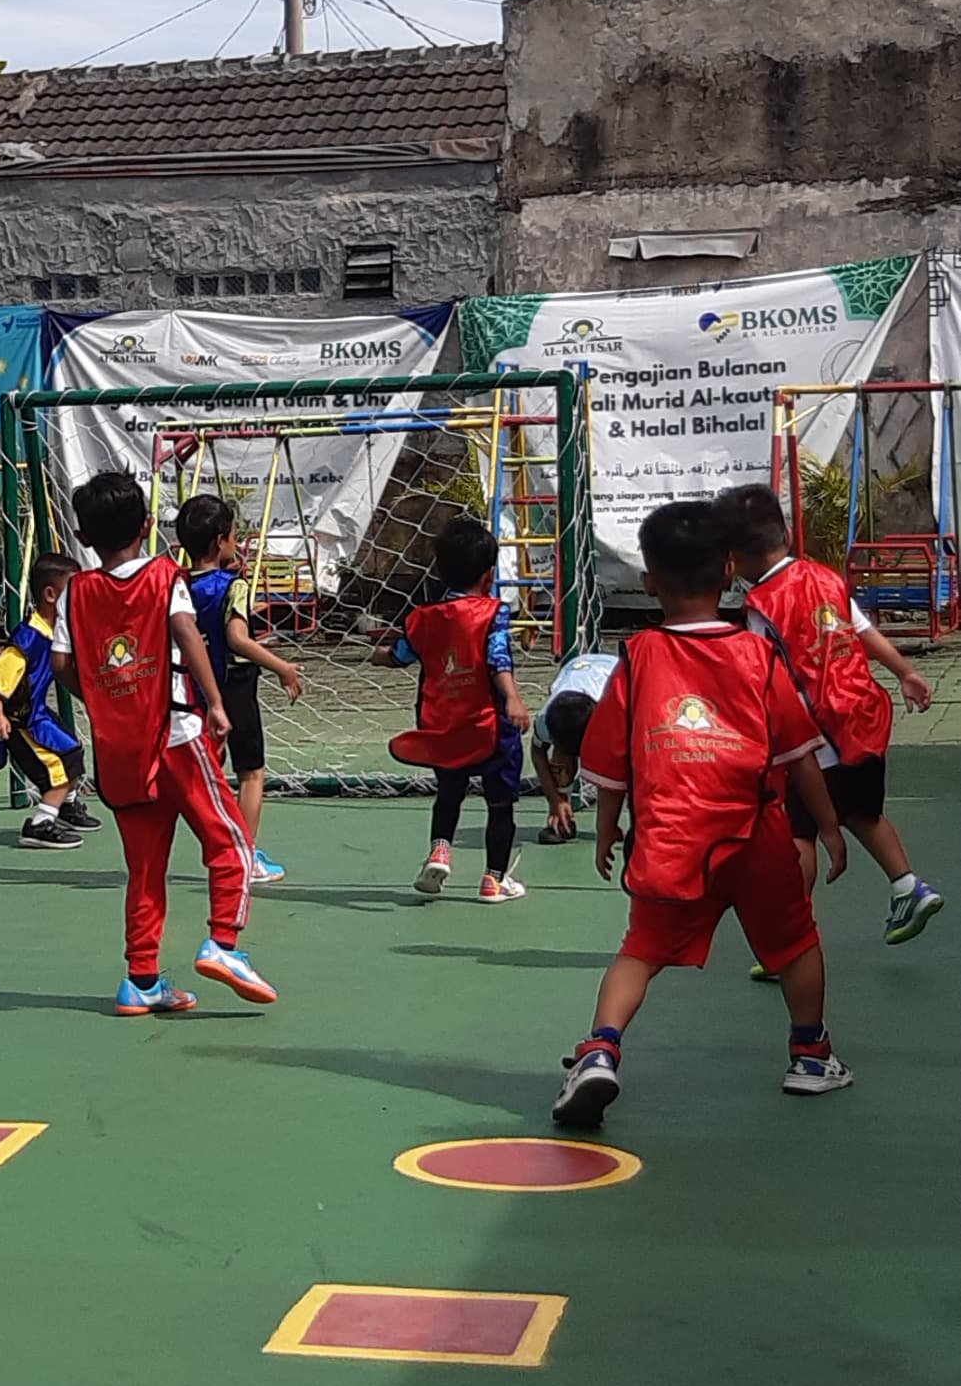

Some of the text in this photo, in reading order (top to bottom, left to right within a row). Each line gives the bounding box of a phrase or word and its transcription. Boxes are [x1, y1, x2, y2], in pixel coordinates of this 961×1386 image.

[741, 305, 837, 330] BKOMS
[320, 340, 401, 359] BKOMS
[542, 341, 623, 357] AL-KAUTSAR
[588, 358, 787, 387] Pengajian Bulanan
[590, 384, 802, 412] ali Murid Al-kauts
[608, 413, 766, 438] & Halal Bihalal
[647, 490, 675, 501] yang
